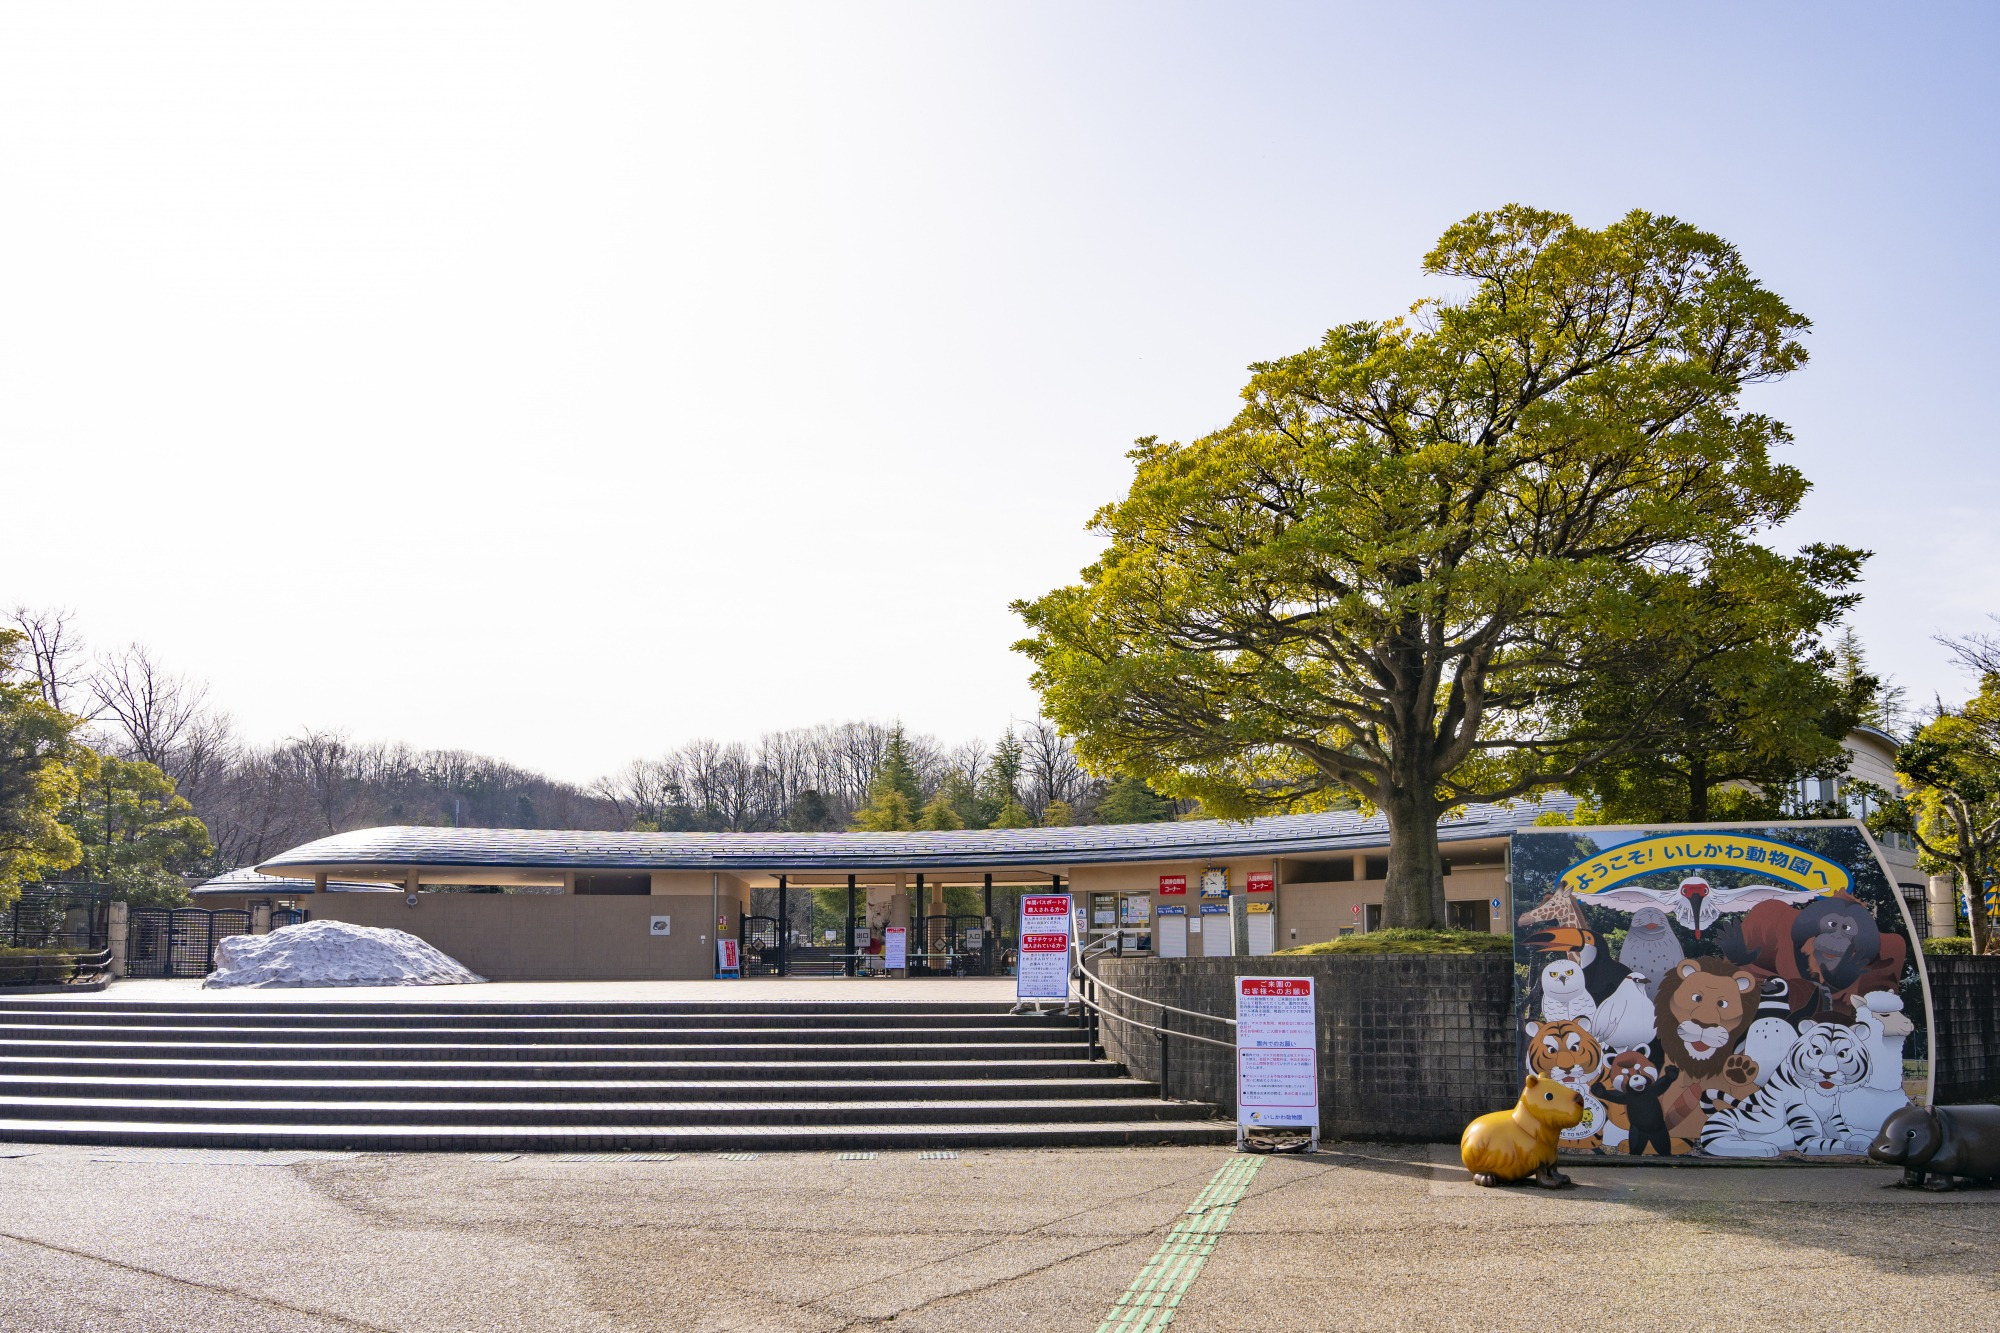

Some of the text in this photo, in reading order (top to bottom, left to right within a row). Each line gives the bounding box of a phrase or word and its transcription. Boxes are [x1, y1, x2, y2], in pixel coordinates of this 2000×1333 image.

[1665, 843, 1828, 885] いしかわ動物園へ
[1260, 980, 1292, 988] ご来園の
